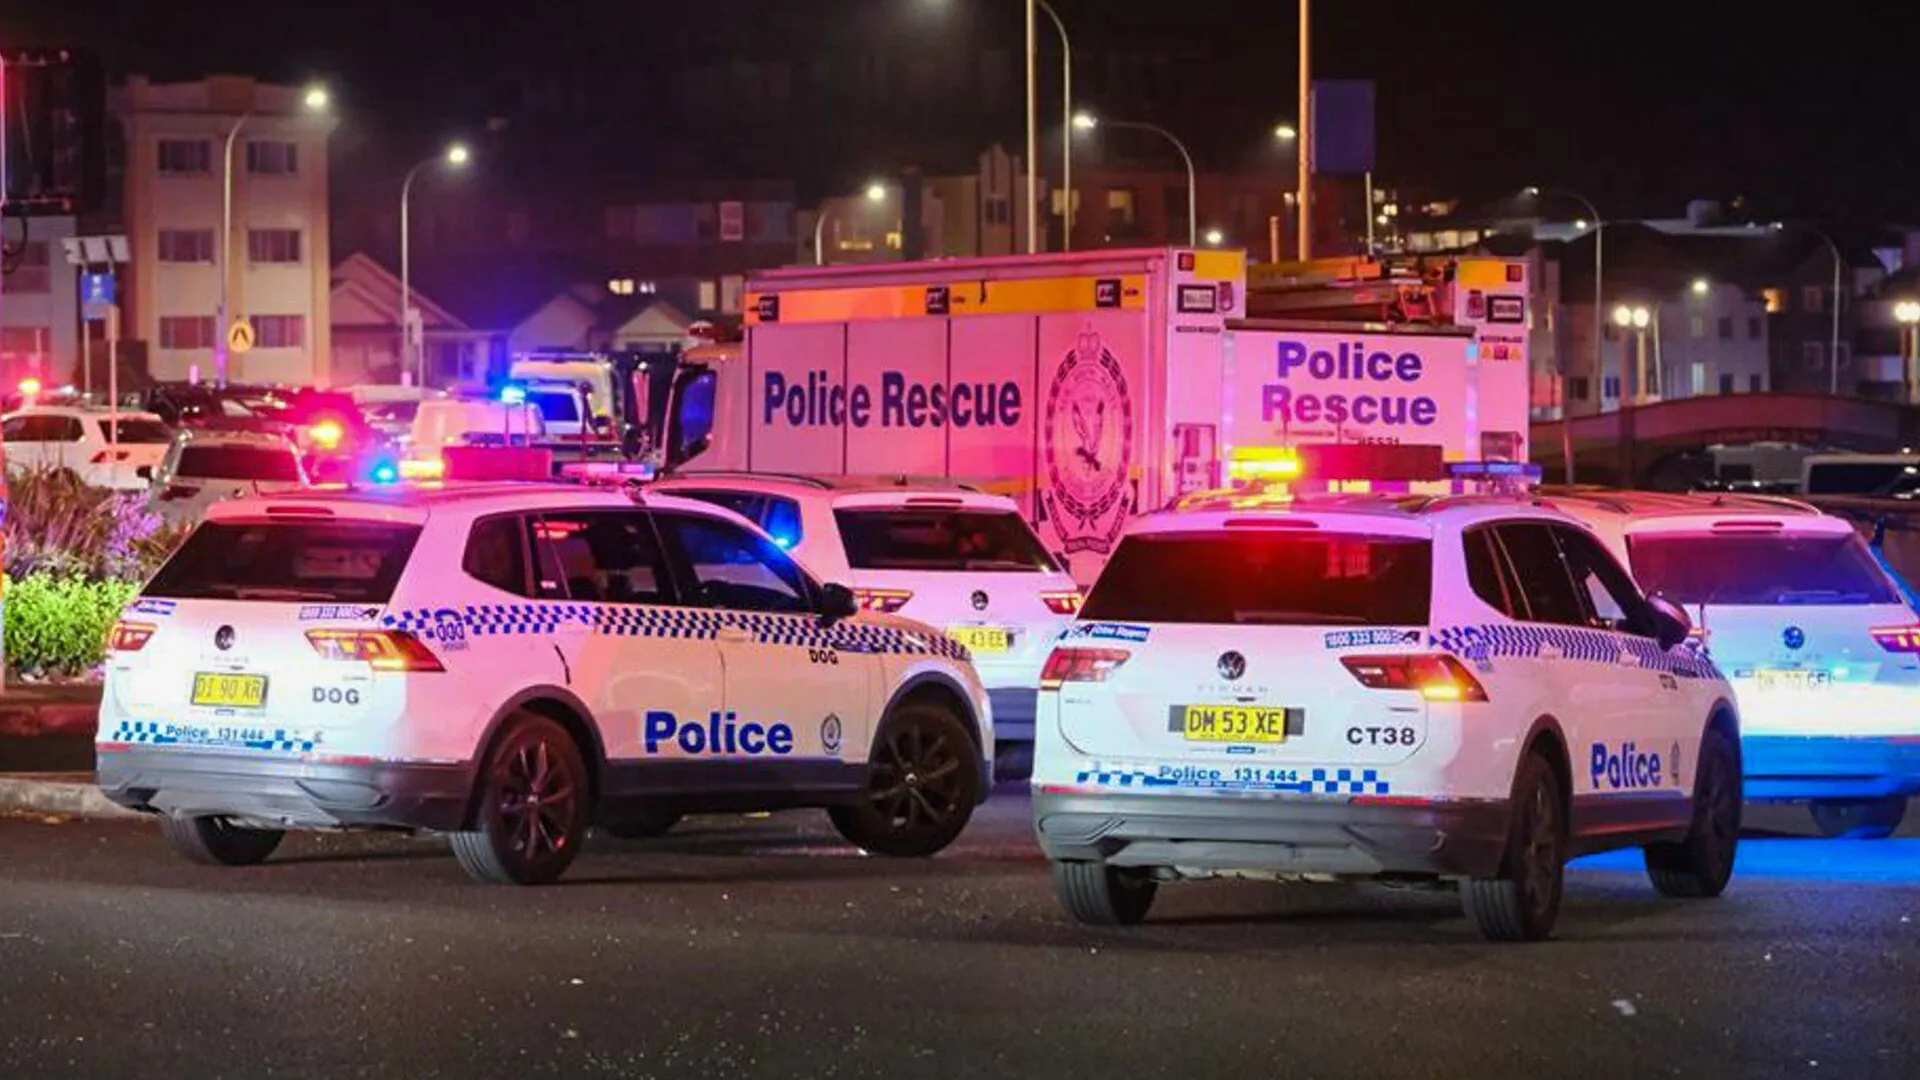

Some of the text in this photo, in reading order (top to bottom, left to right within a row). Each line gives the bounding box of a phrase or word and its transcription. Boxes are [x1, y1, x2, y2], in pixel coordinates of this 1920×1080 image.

[1277, 341, 1423, 382] Police
[764, 370, 1021, 428] Police Rescue
[1262, 384, 1437, 426] Rescue
[809, 649, 840, 665] DOG
[312, 687, 361, 705] DOG
[166, 725, 209, 739] Police
[644, 711, 794, 754] Police
[1222, 711, 1249, 734] 53
[1255, 712, 1281, 735] XE
[1346, 727, 1416, 746] CT38
[1159, 764, 1221, 781] Police
[1592, 742, 1661, 789] Police
